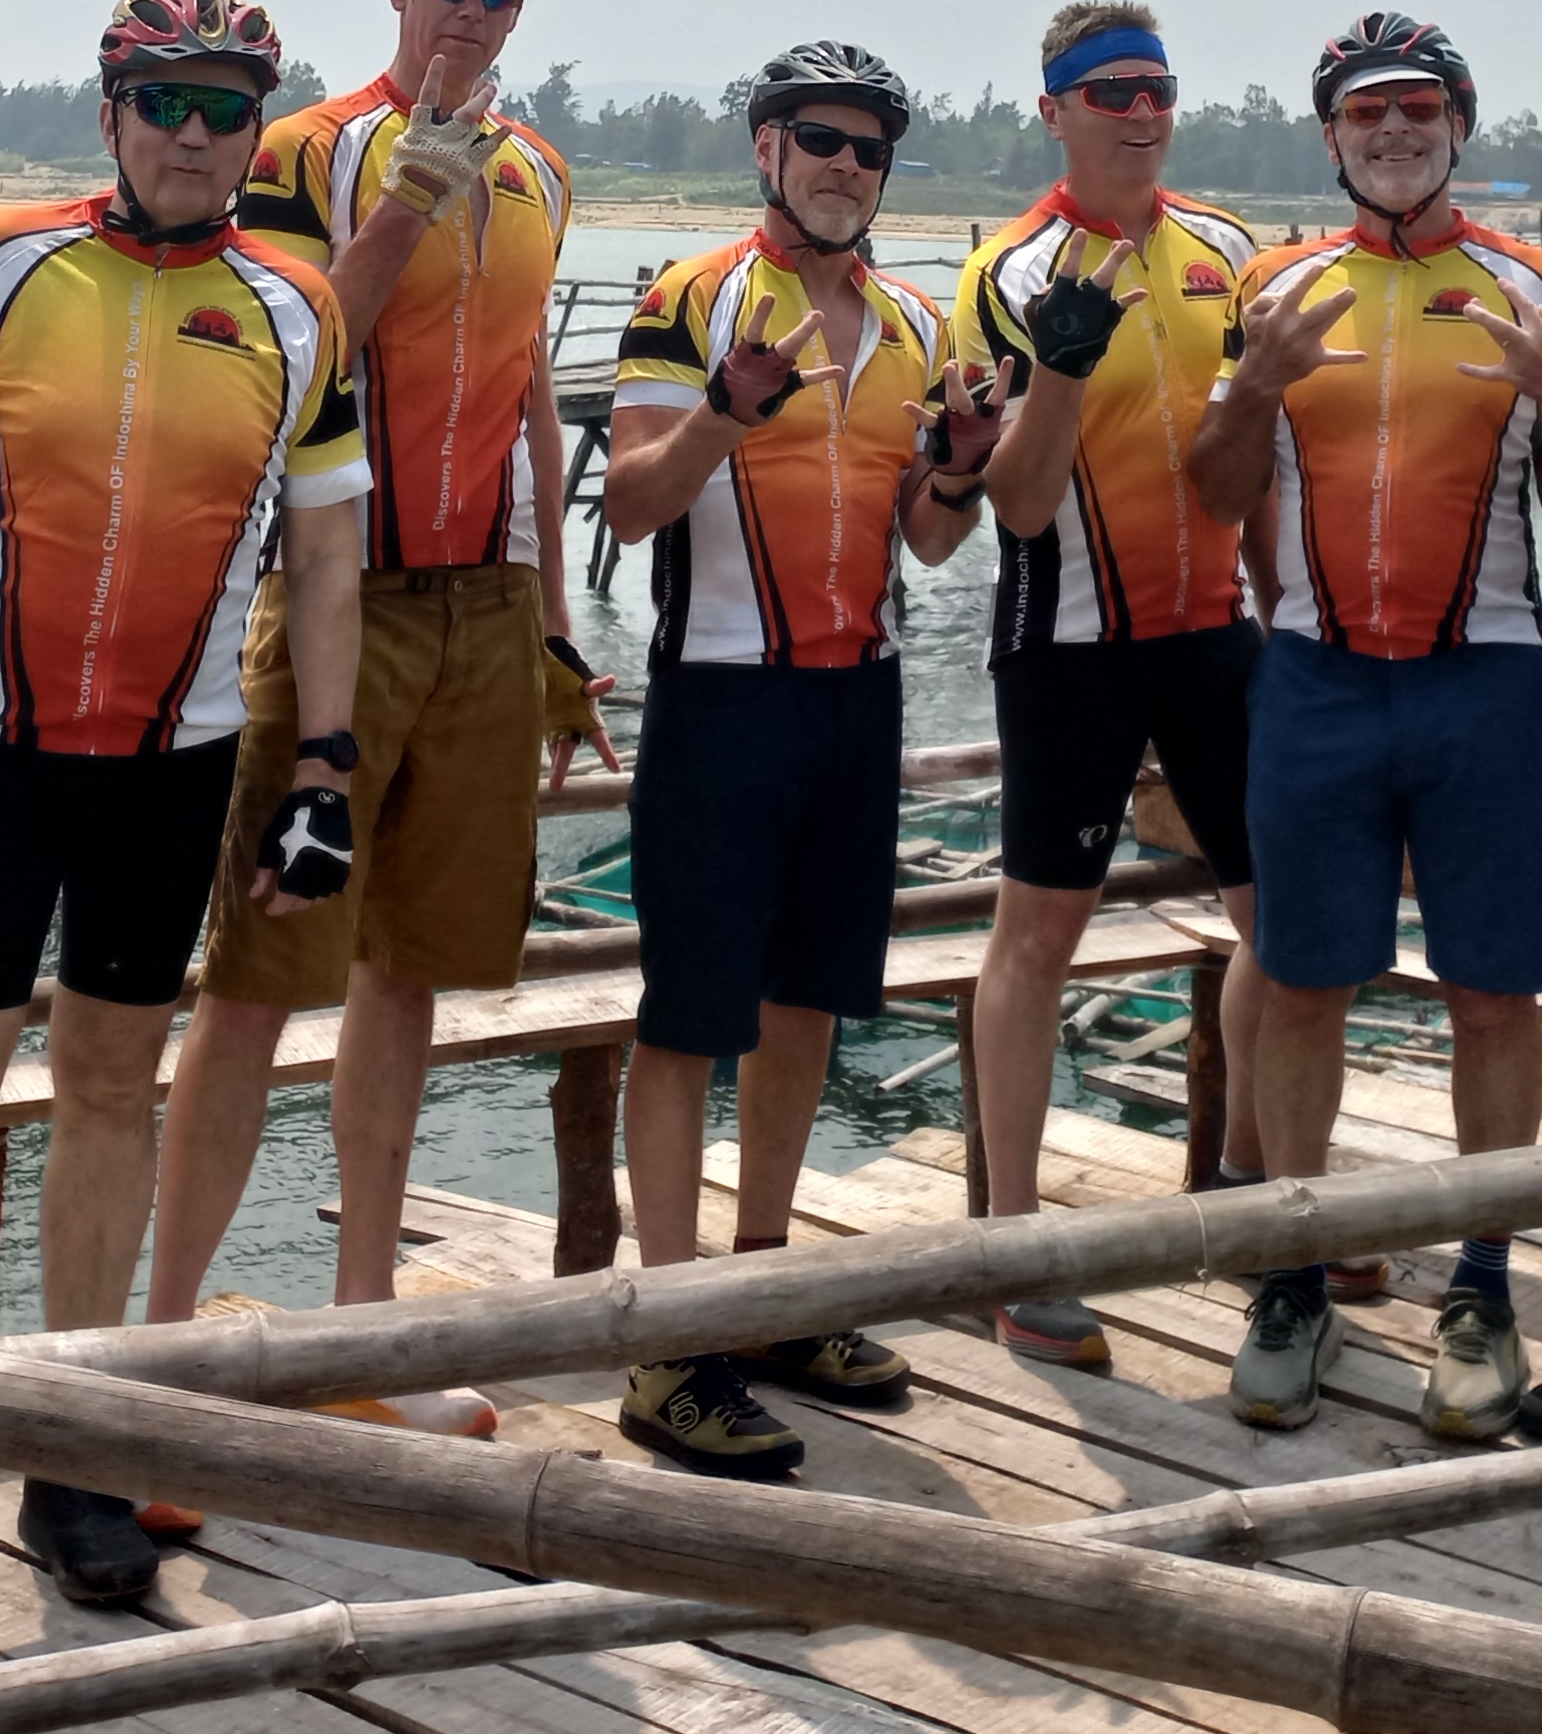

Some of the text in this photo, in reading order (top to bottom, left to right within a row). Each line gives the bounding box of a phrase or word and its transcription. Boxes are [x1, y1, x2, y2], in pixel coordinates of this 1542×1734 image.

[124, 319, 140, 353] Your
[452, 328, 465, 373] Charm
[122, 358, 140, 378] By
[111, 383, 136, 460] Indochina
[446, 377, 463, 428] Hidden
[441, 432, 454, 456] The
[109, 465, 124, 489] OF
[830, 465, 841, 509] Charm
[1371, 447, 1387, 490] Charm
[432, 461, 452, 531] Discovers
[102, 494, 123, 551] Charm
[829, 514, 841, 562] Hidden
[1368, 494, 1381, 543] Hidden
[826, 566, 837, 591] The
[1368, 546, 1380, 571] The
[89, 556, 115, 616] Hidden
[83, 621, 102, 646] The
[72, 651, 96, 720] iscovers
